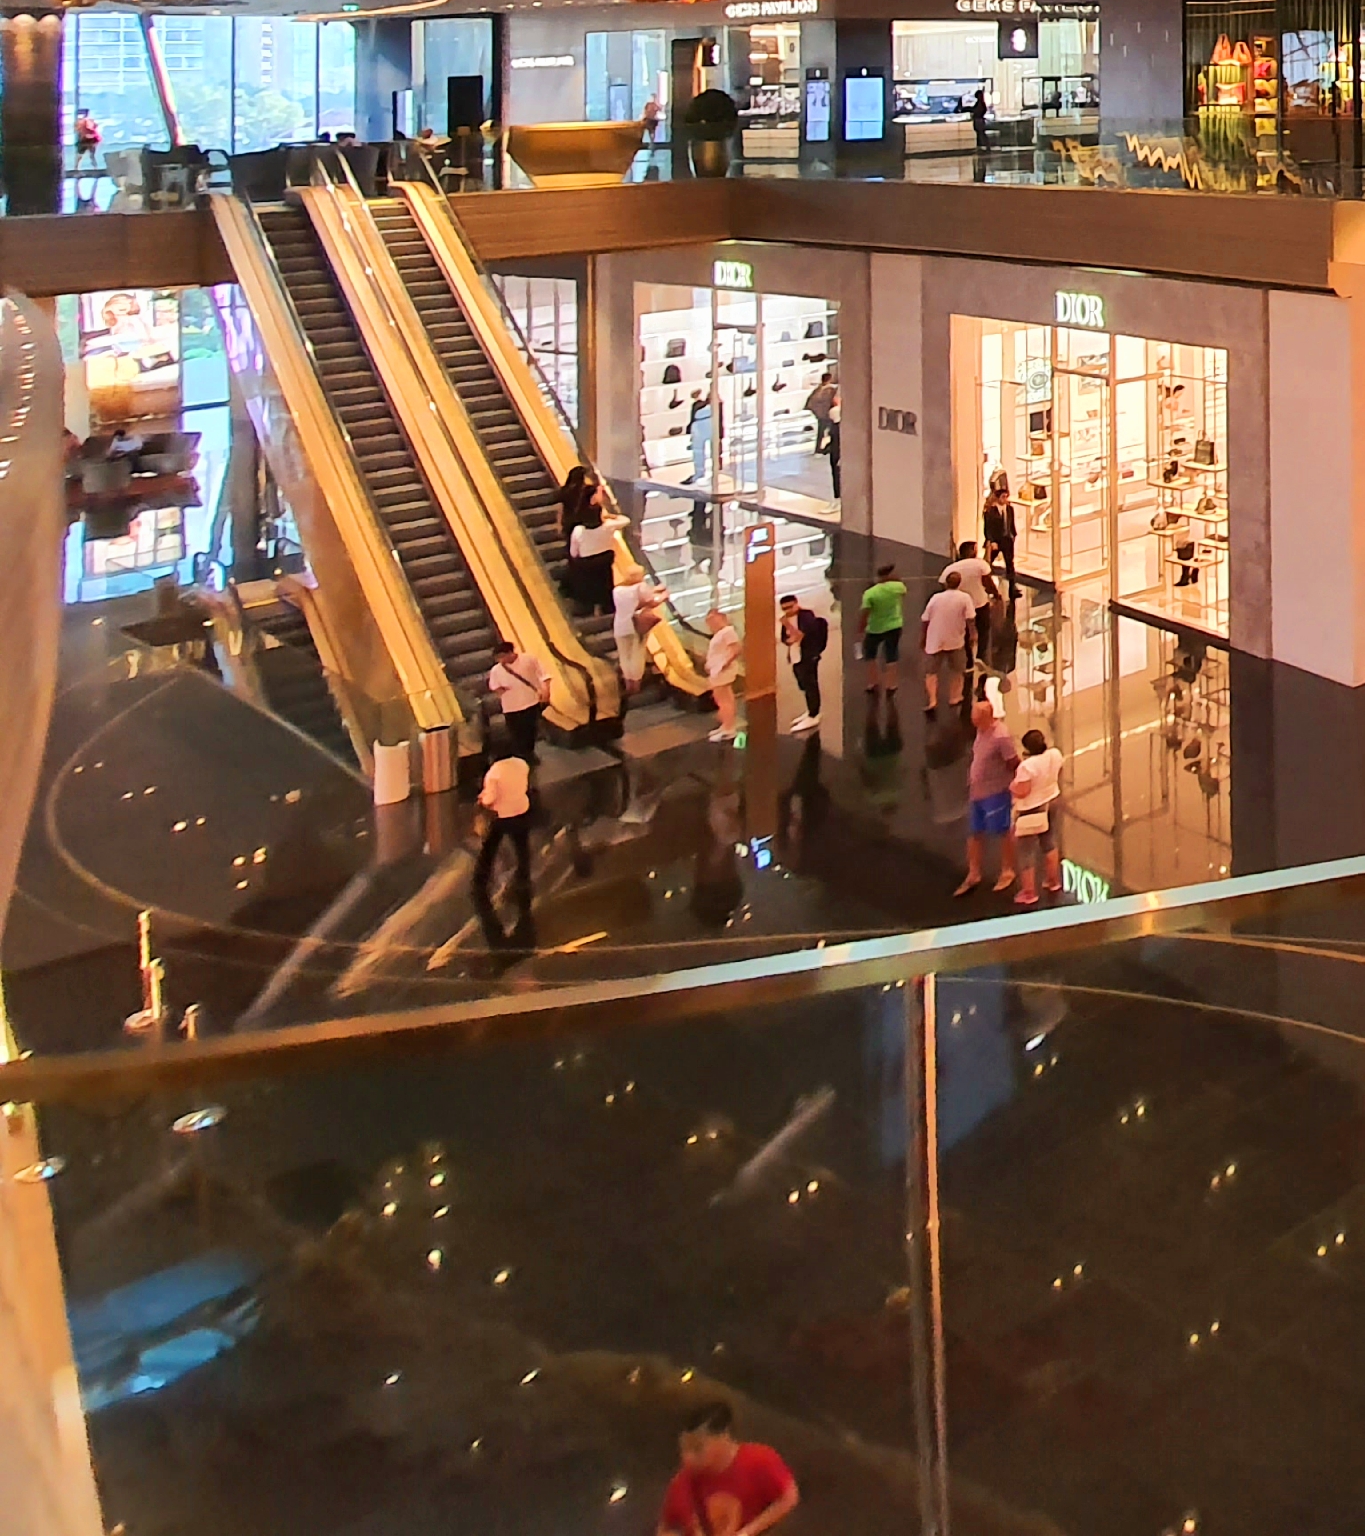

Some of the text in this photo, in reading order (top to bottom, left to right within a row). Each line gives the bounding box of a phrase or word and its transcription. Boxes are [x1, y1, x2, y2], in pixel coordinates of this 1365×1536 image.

[714, 260, 753, 288] DIOR
[1055, 290, 1105, 328] DIOR
[878, 406, 918, 437] DIOR
